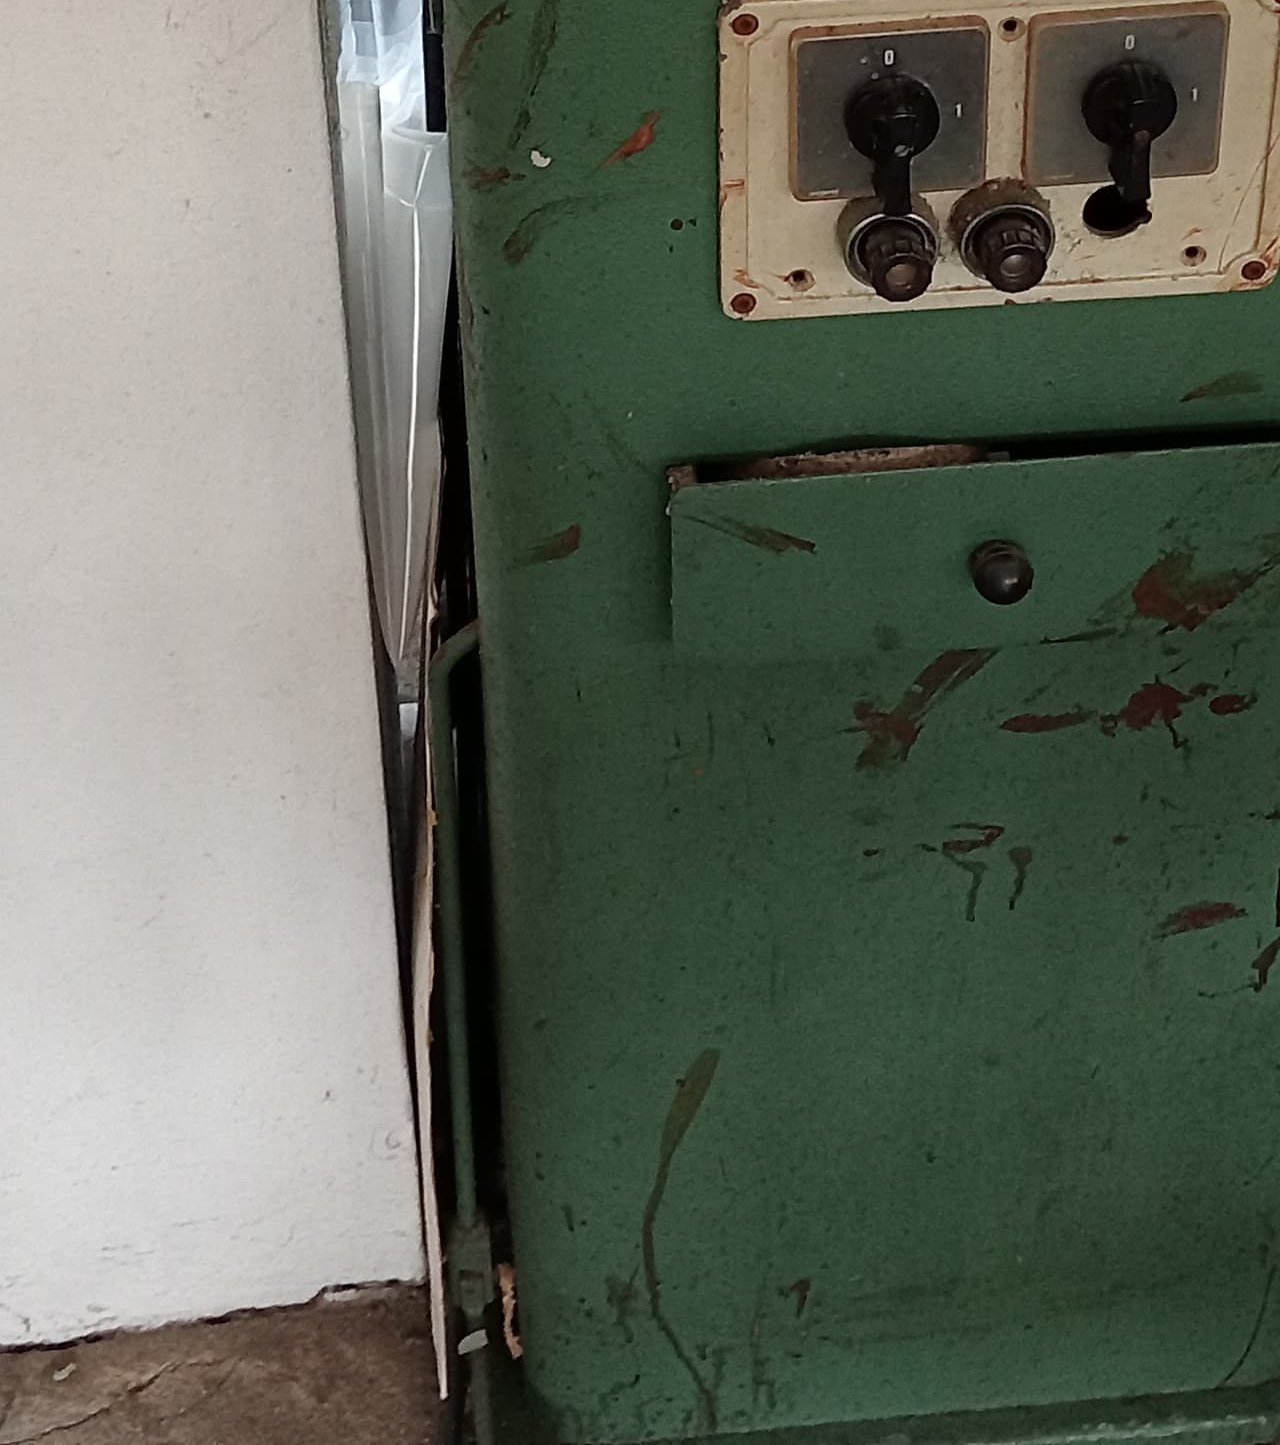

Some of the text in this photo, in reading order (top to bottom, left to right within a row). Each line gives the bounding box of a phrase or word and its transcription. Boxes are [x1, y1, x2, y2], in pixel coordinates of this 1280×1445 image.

[1124, 34, 1136, 50] 0
[883, 49, 895, 66] 0
[1191, 87, 1199, 102] 1
[954, 103, 963, 119] 1
